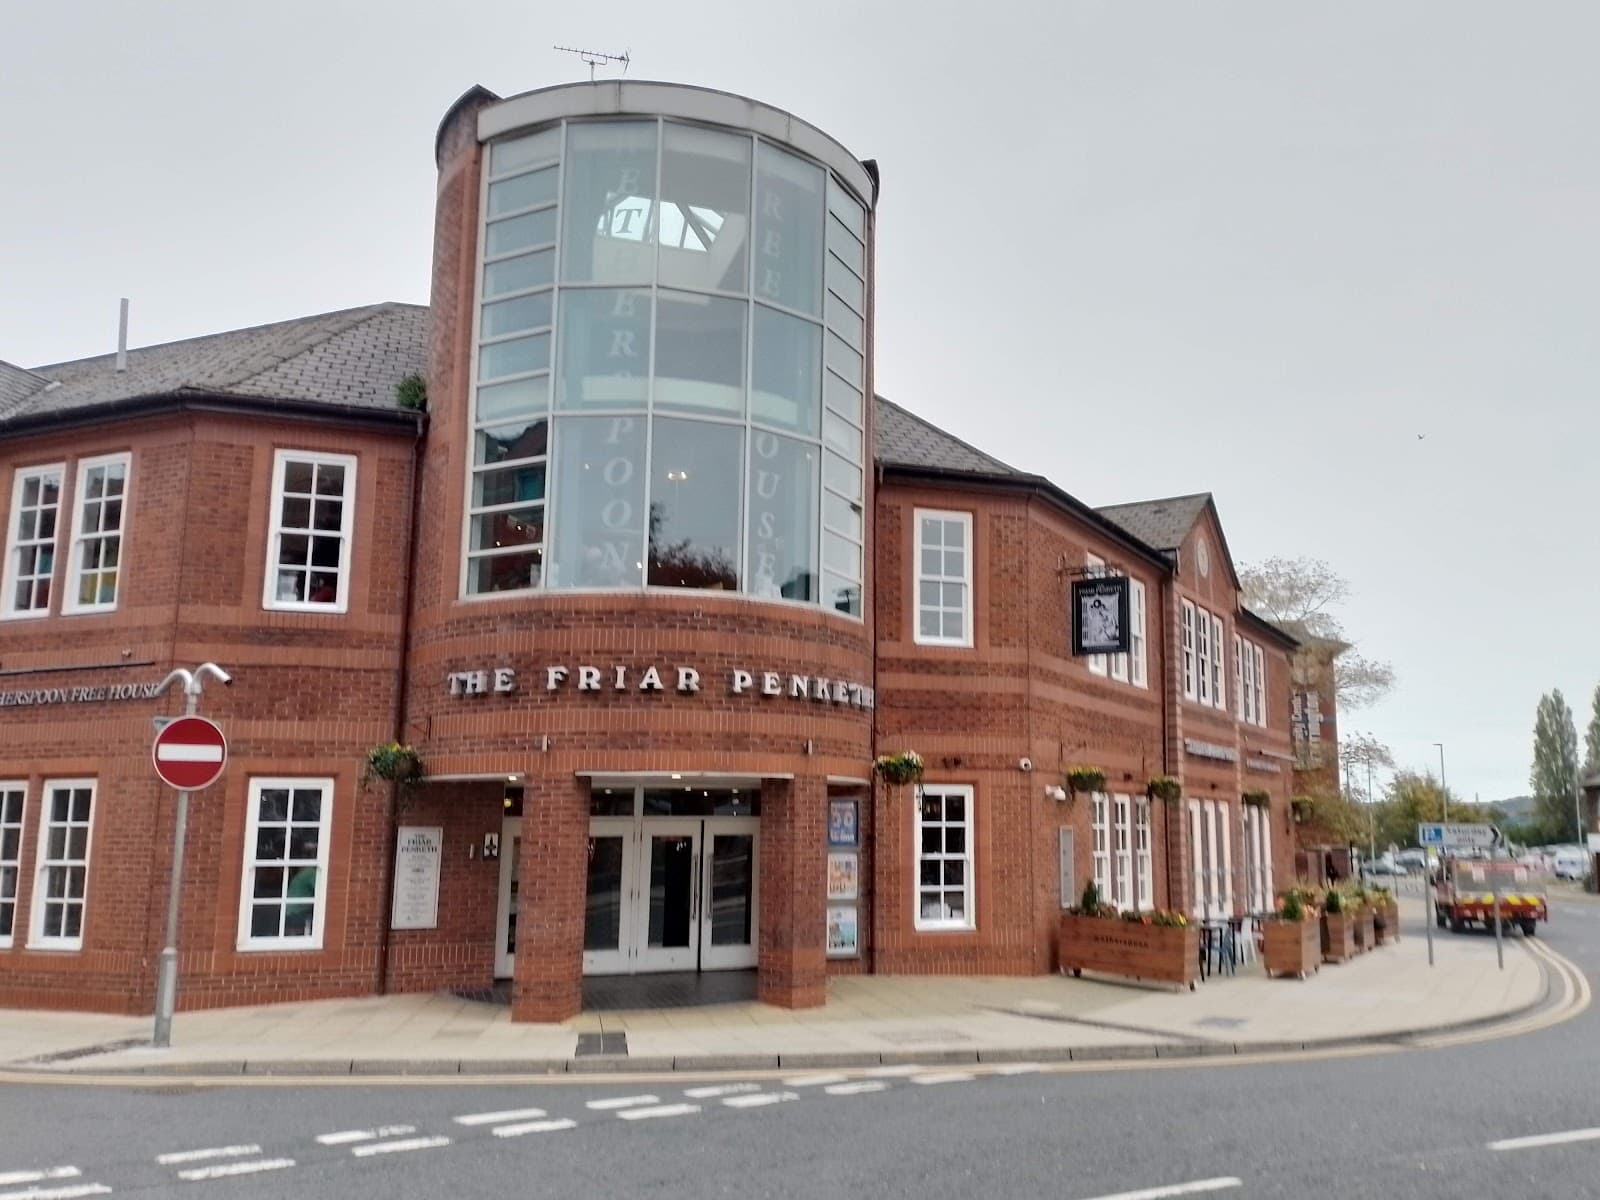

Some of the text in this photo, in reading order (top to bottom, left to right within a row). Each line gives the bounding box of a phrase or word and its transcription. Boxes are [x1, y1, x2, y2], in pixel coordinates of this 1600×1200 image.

[447, 668, 516, 695] THE
[547, 665, 700, 691] FRIAR
[71, 686, 106, 702] FREE
